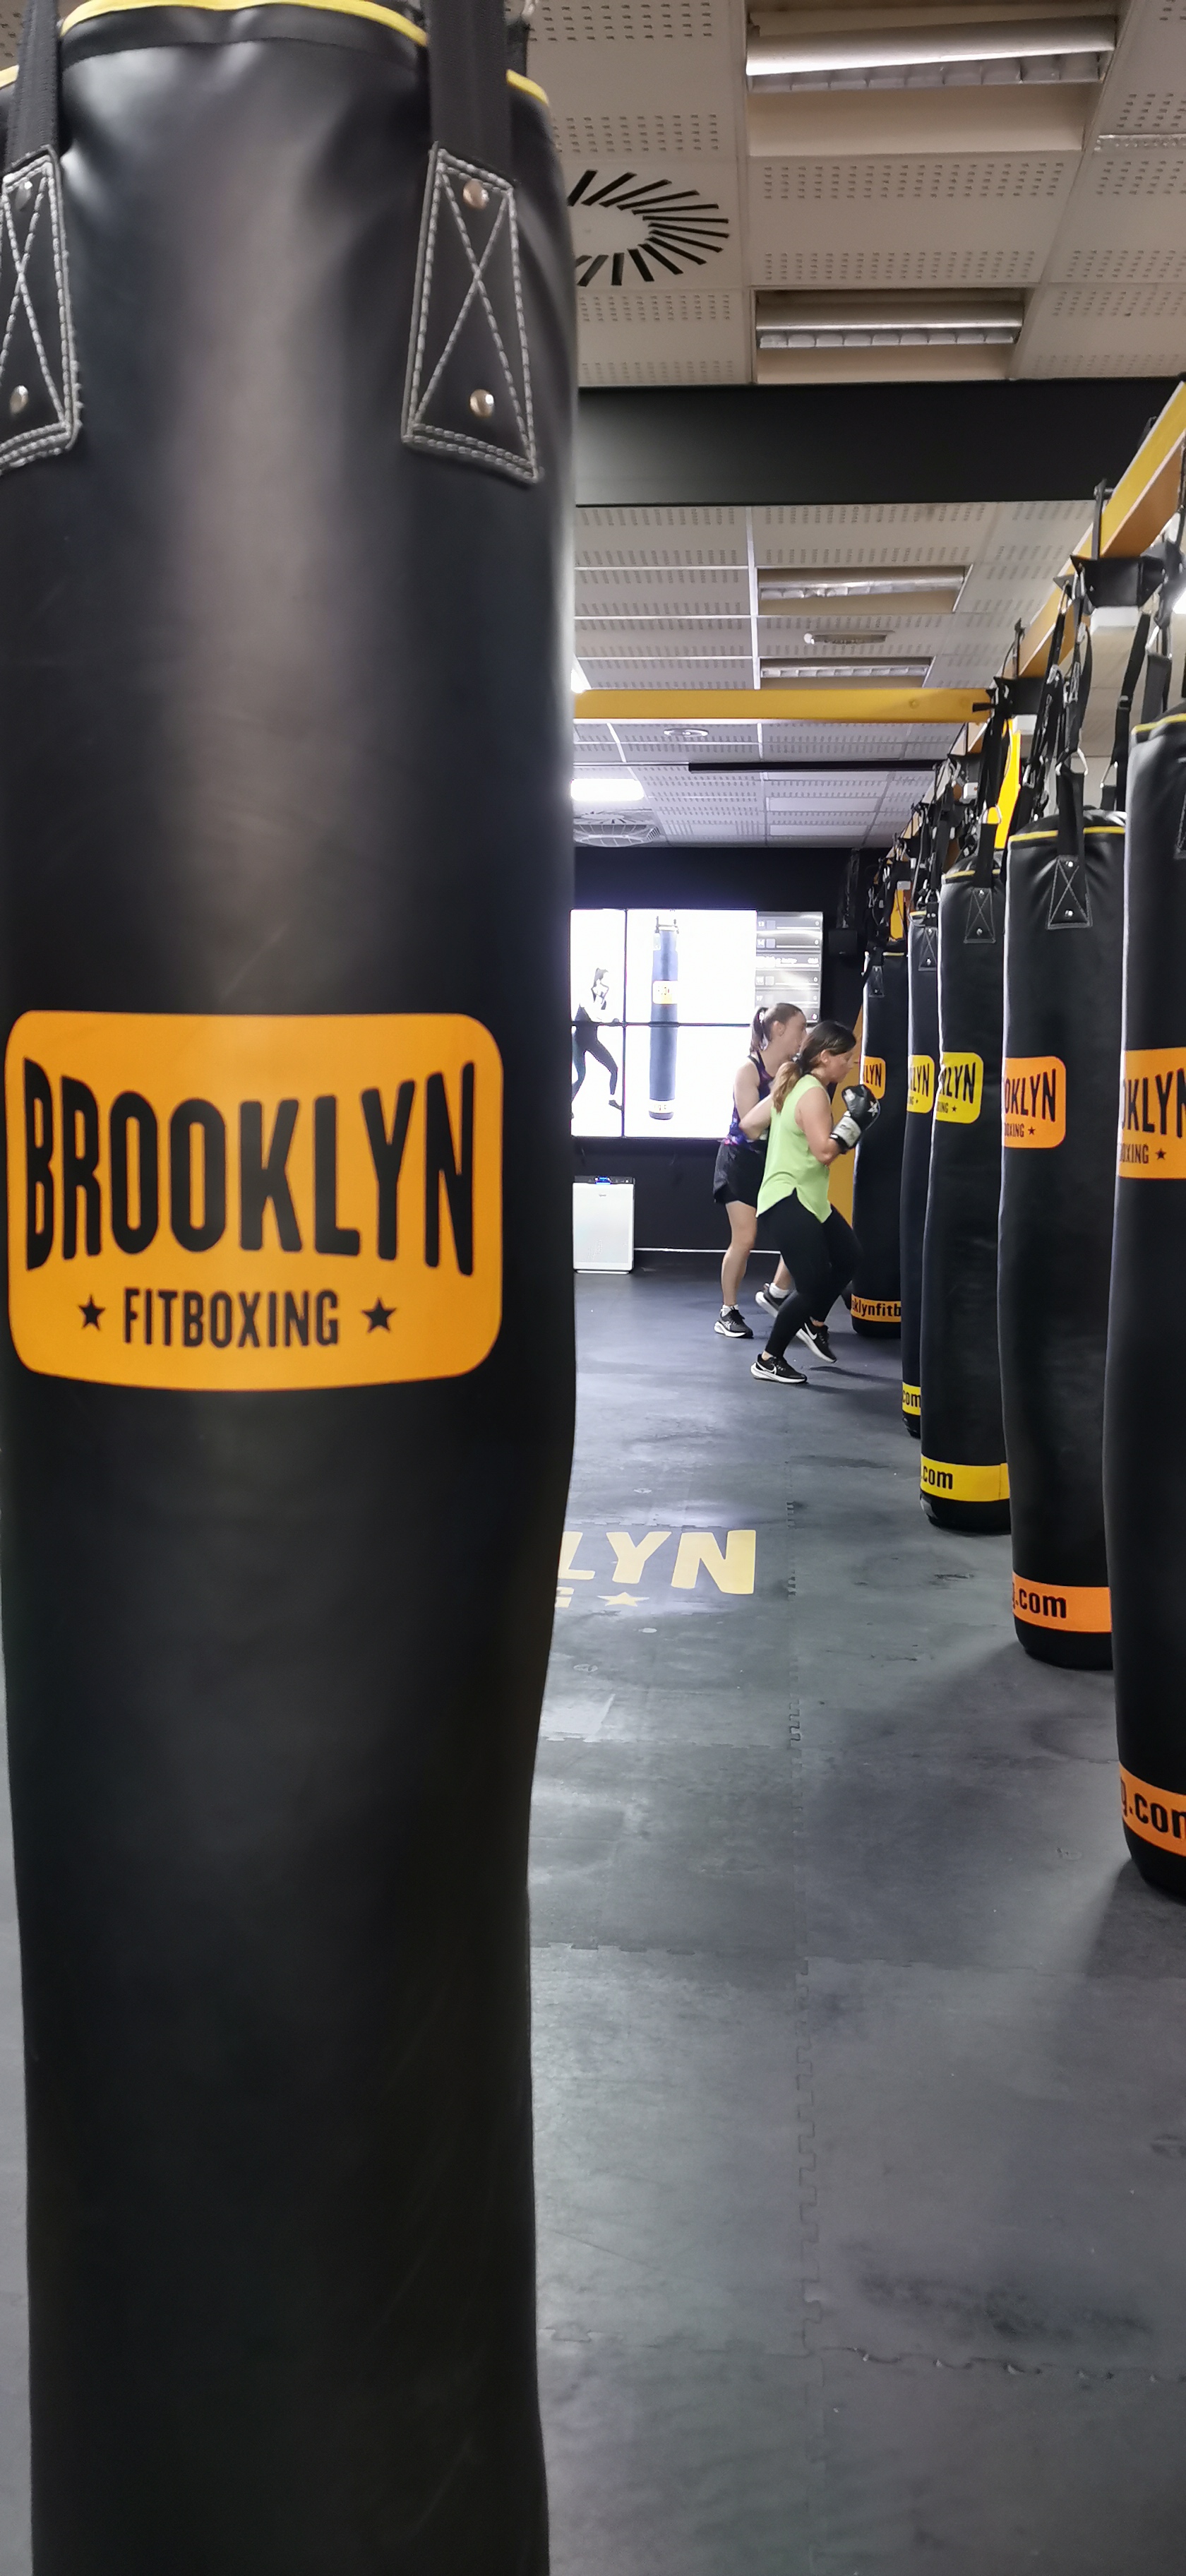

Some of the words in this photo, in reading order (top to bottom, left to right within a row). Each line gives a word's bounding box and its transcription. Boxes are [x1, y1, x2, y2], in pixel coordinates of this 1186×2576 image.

[863, 1063, 882, 1087] LYN
[23, 1057, 475, 1276] BROOKLYN
[124, 1289, 339, 1348] FITBOXING
